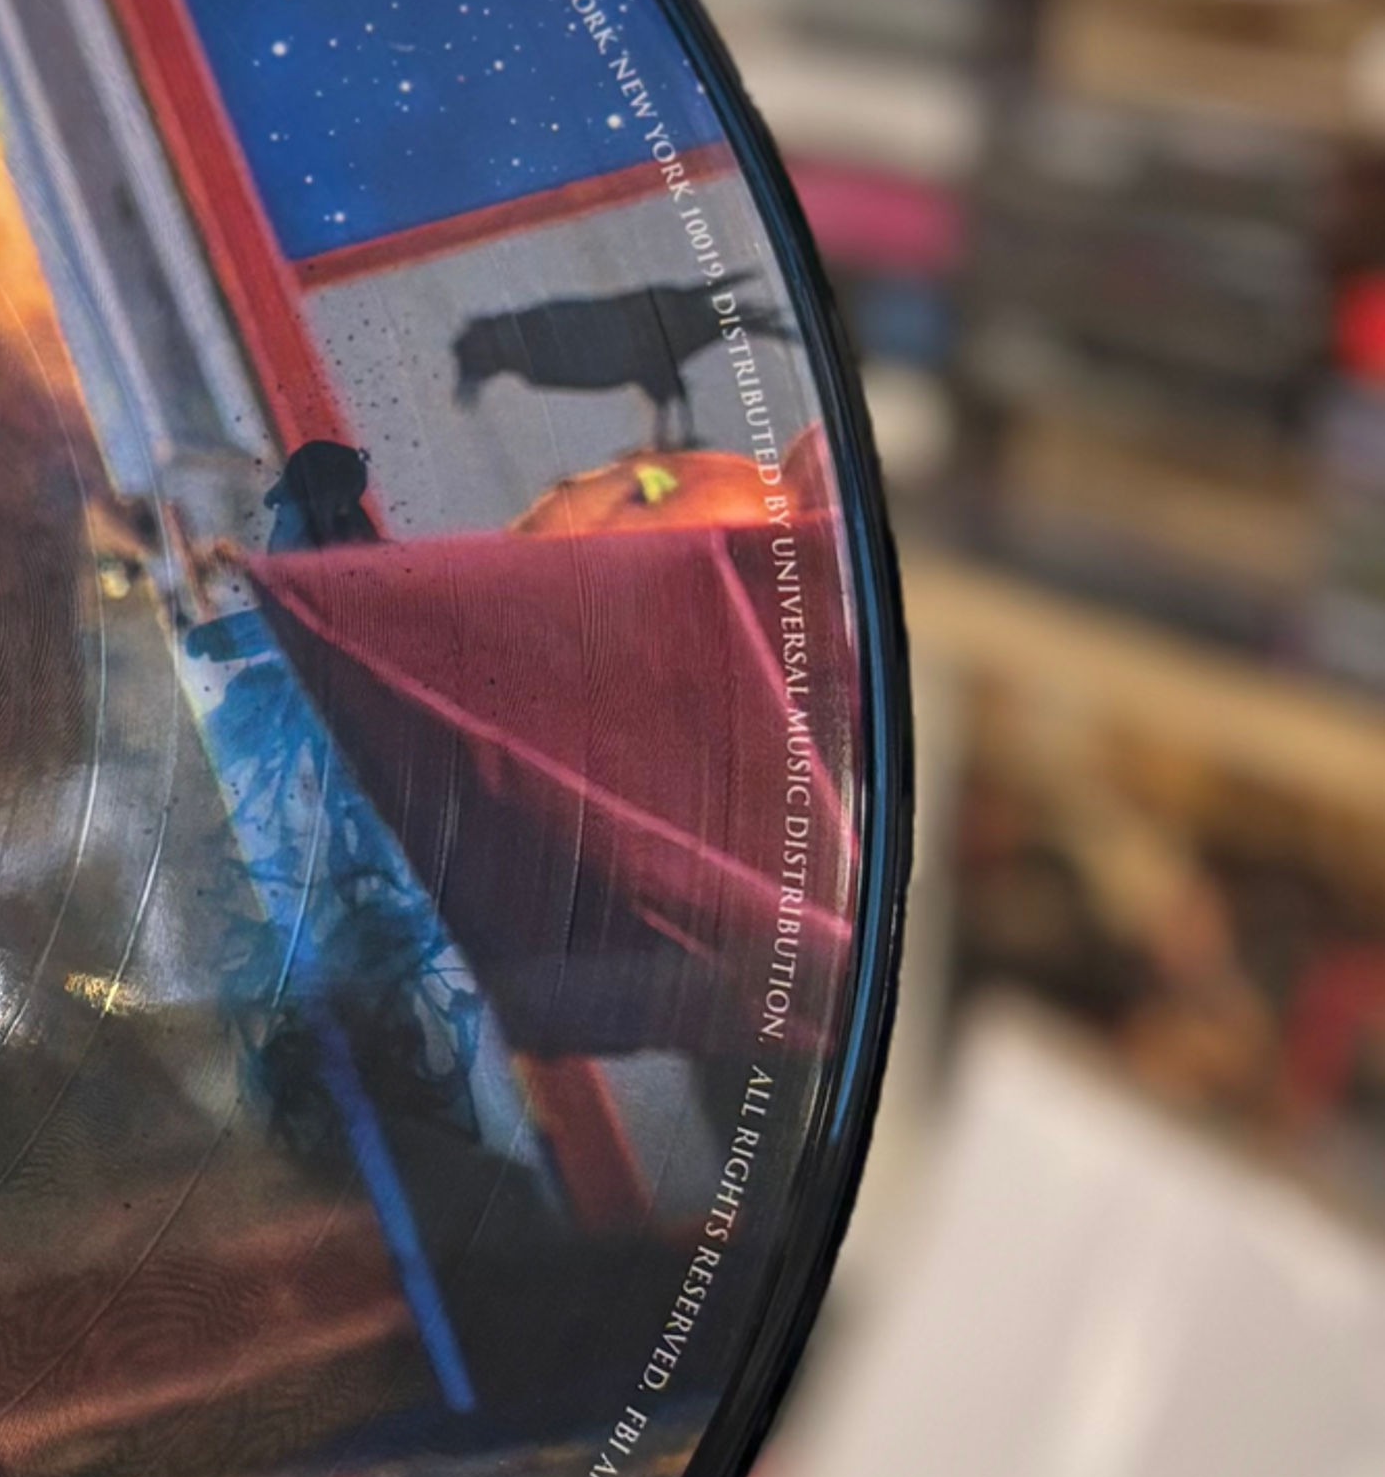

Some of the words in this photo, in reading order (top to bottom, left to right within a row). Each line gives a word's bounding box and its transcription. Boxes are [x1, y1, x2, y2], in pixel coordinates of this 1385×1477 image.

[608, 56, 658, 120] NEW
[643, 122, 696, 203] YORK
[710, 289, 782, 486] DISTRIBUTED
[763, 494, 792, 530] BY
[771, 537, 809, 699] UNIVERSAL
[786, 707, 811, 807] MUSIC
[758, 814, 811, 1044] DISTRIBUTION.
[740, 1064, 775, 1118] ALL
[704, 1125, 762, 1243] RIGHTS
[637, 1244, 723, 1392] RESERVED.
[608, 1404, 649, 1456] FBI
